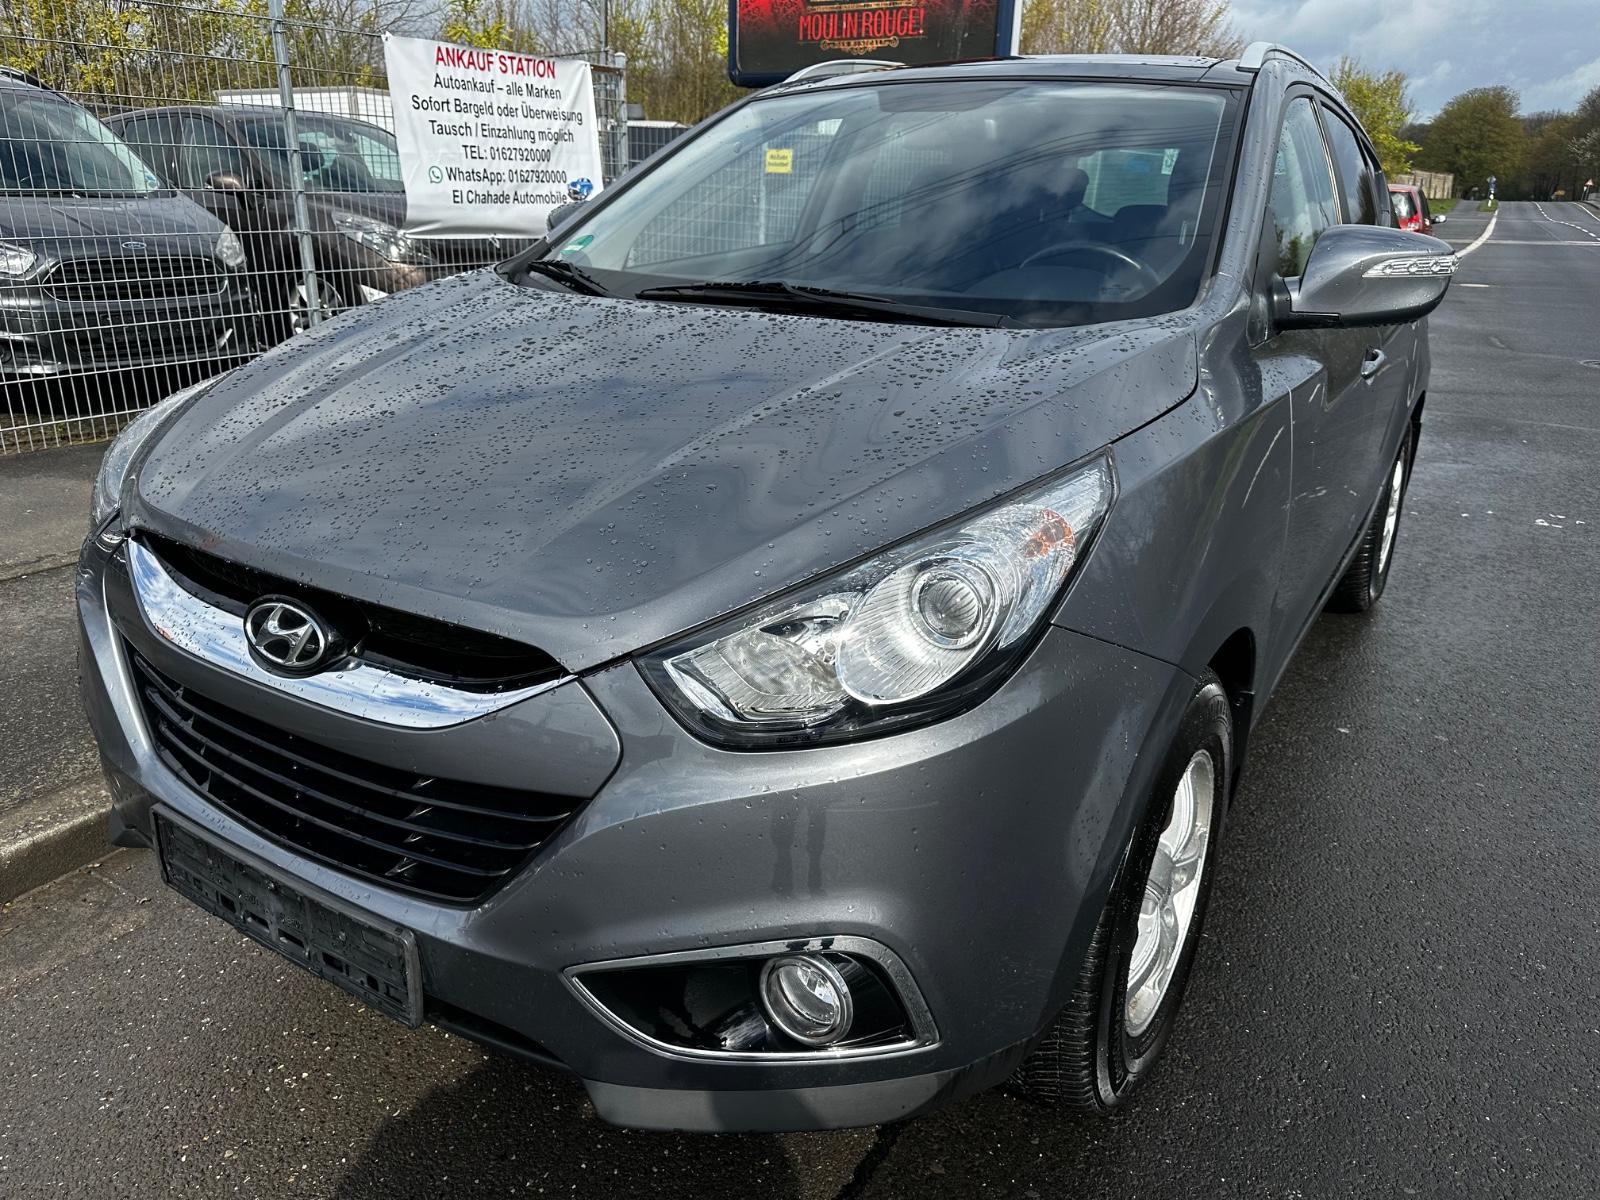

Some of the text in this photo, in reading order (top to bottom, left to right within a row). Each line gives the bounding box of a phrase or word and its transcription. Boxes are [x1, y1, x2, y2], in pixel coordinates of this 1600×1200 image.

[799, 8, 925, 41] MOULIN ROUGE!
[435, 46, 556, 79] ANKAUF STATION
[434, 73, 495, 93] Autoankauf
[506, 81, 523, 96] alle
[526, 83, 561, 100] Marken
[411, 94, 583, 125] Sofort Bargeld oder Überweisung
[428, 119, 472, 137] Tausch
[480, 123, 536, 144] Einzahlung
[538, 127, 574, 145] möglich
[462, 144, 551, 162] TEL: 01627920000
[445, 166, 567, 186] WhatsApp: 01627920000
[452, 189, 567, 204] El Chahade Automobile
